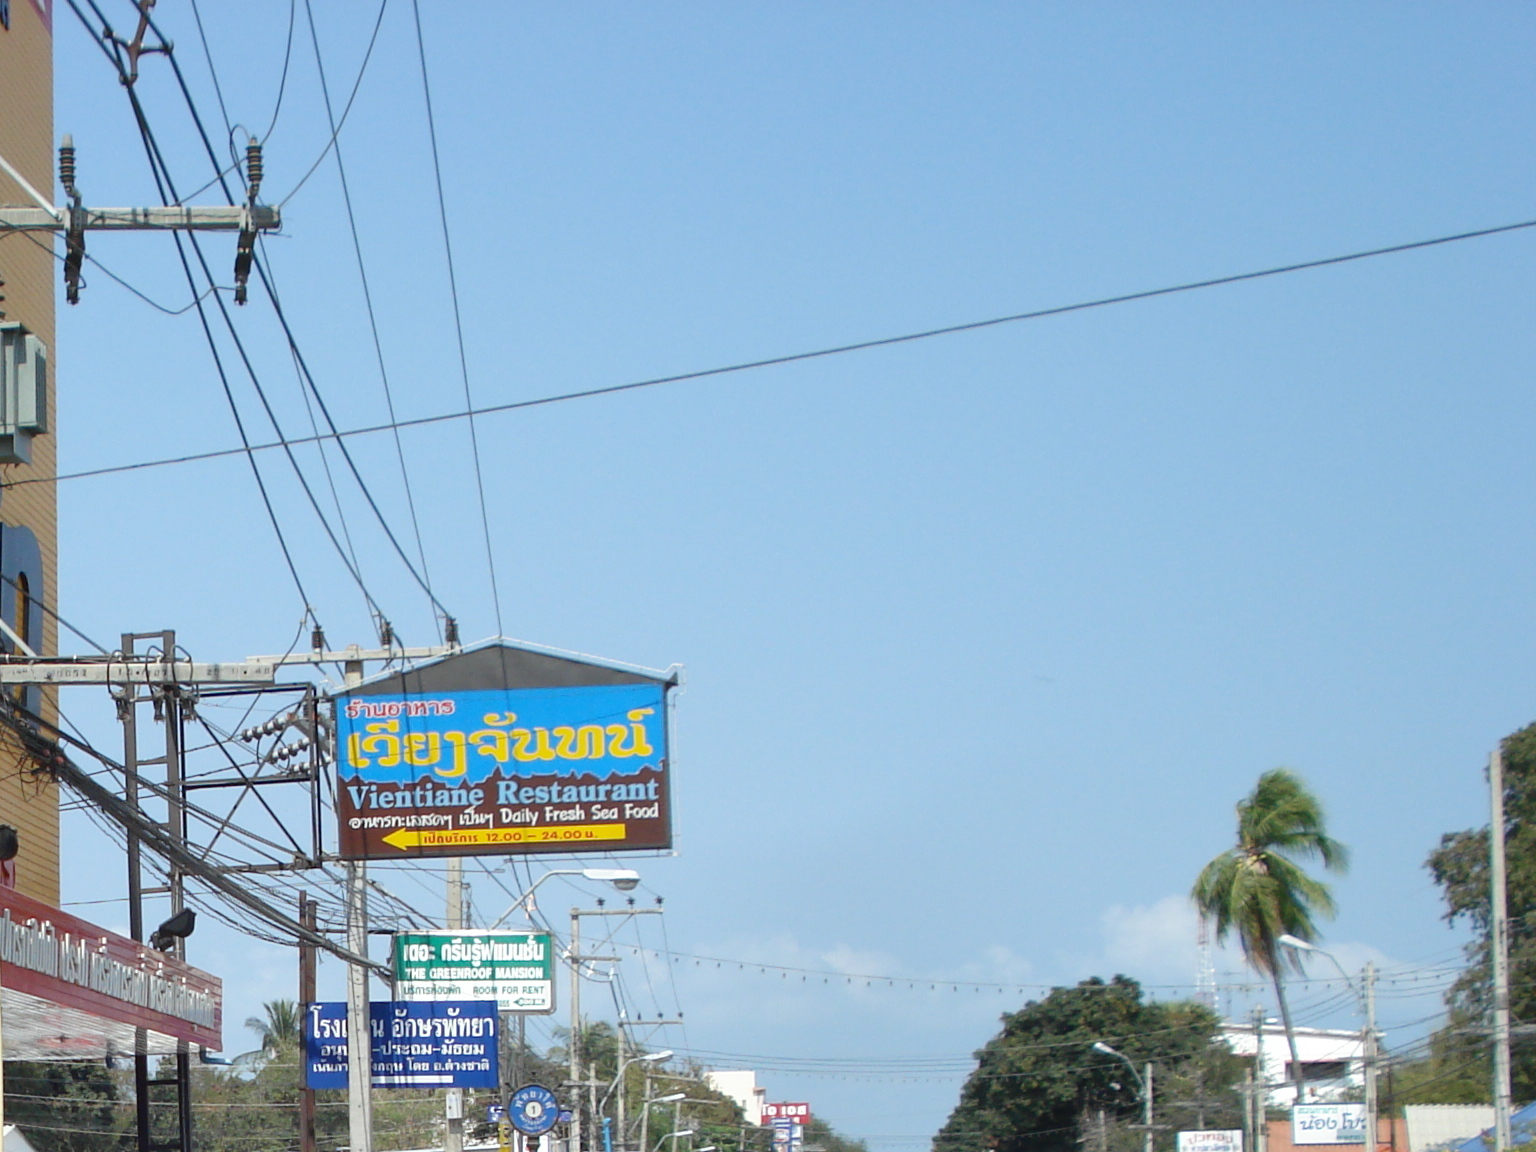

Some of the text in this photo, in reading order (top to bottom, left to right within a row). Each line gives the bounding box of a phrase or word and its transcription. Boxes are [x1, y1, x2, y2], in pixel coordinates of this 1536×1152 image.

[346, 698, 455, 718] ร้านอาหาร
[347, 708, 655, 778] เวียงจันทน์
[346, 777, 660, 810] Vientiane Restaurant
[500, 807, 539, 826] Daily
[544, 804, 586, 822] Fresh
[591, 804, 618, 820] Sea
[624, 802, 660, 819] Food
[485, 832, 522, 842] 12.00
[541, 830, 582, 841] 24.00
[403, 943, 436, 962] เดอะ
[404, 967, 544, 980] THE GREENROOF MANSION
[472, 985, 498, 995] ROOM
[502, 985, 519, 995] FOR
[522, 985, 545, 995] RENT
[407, 1057, 430, 1072] โดย
